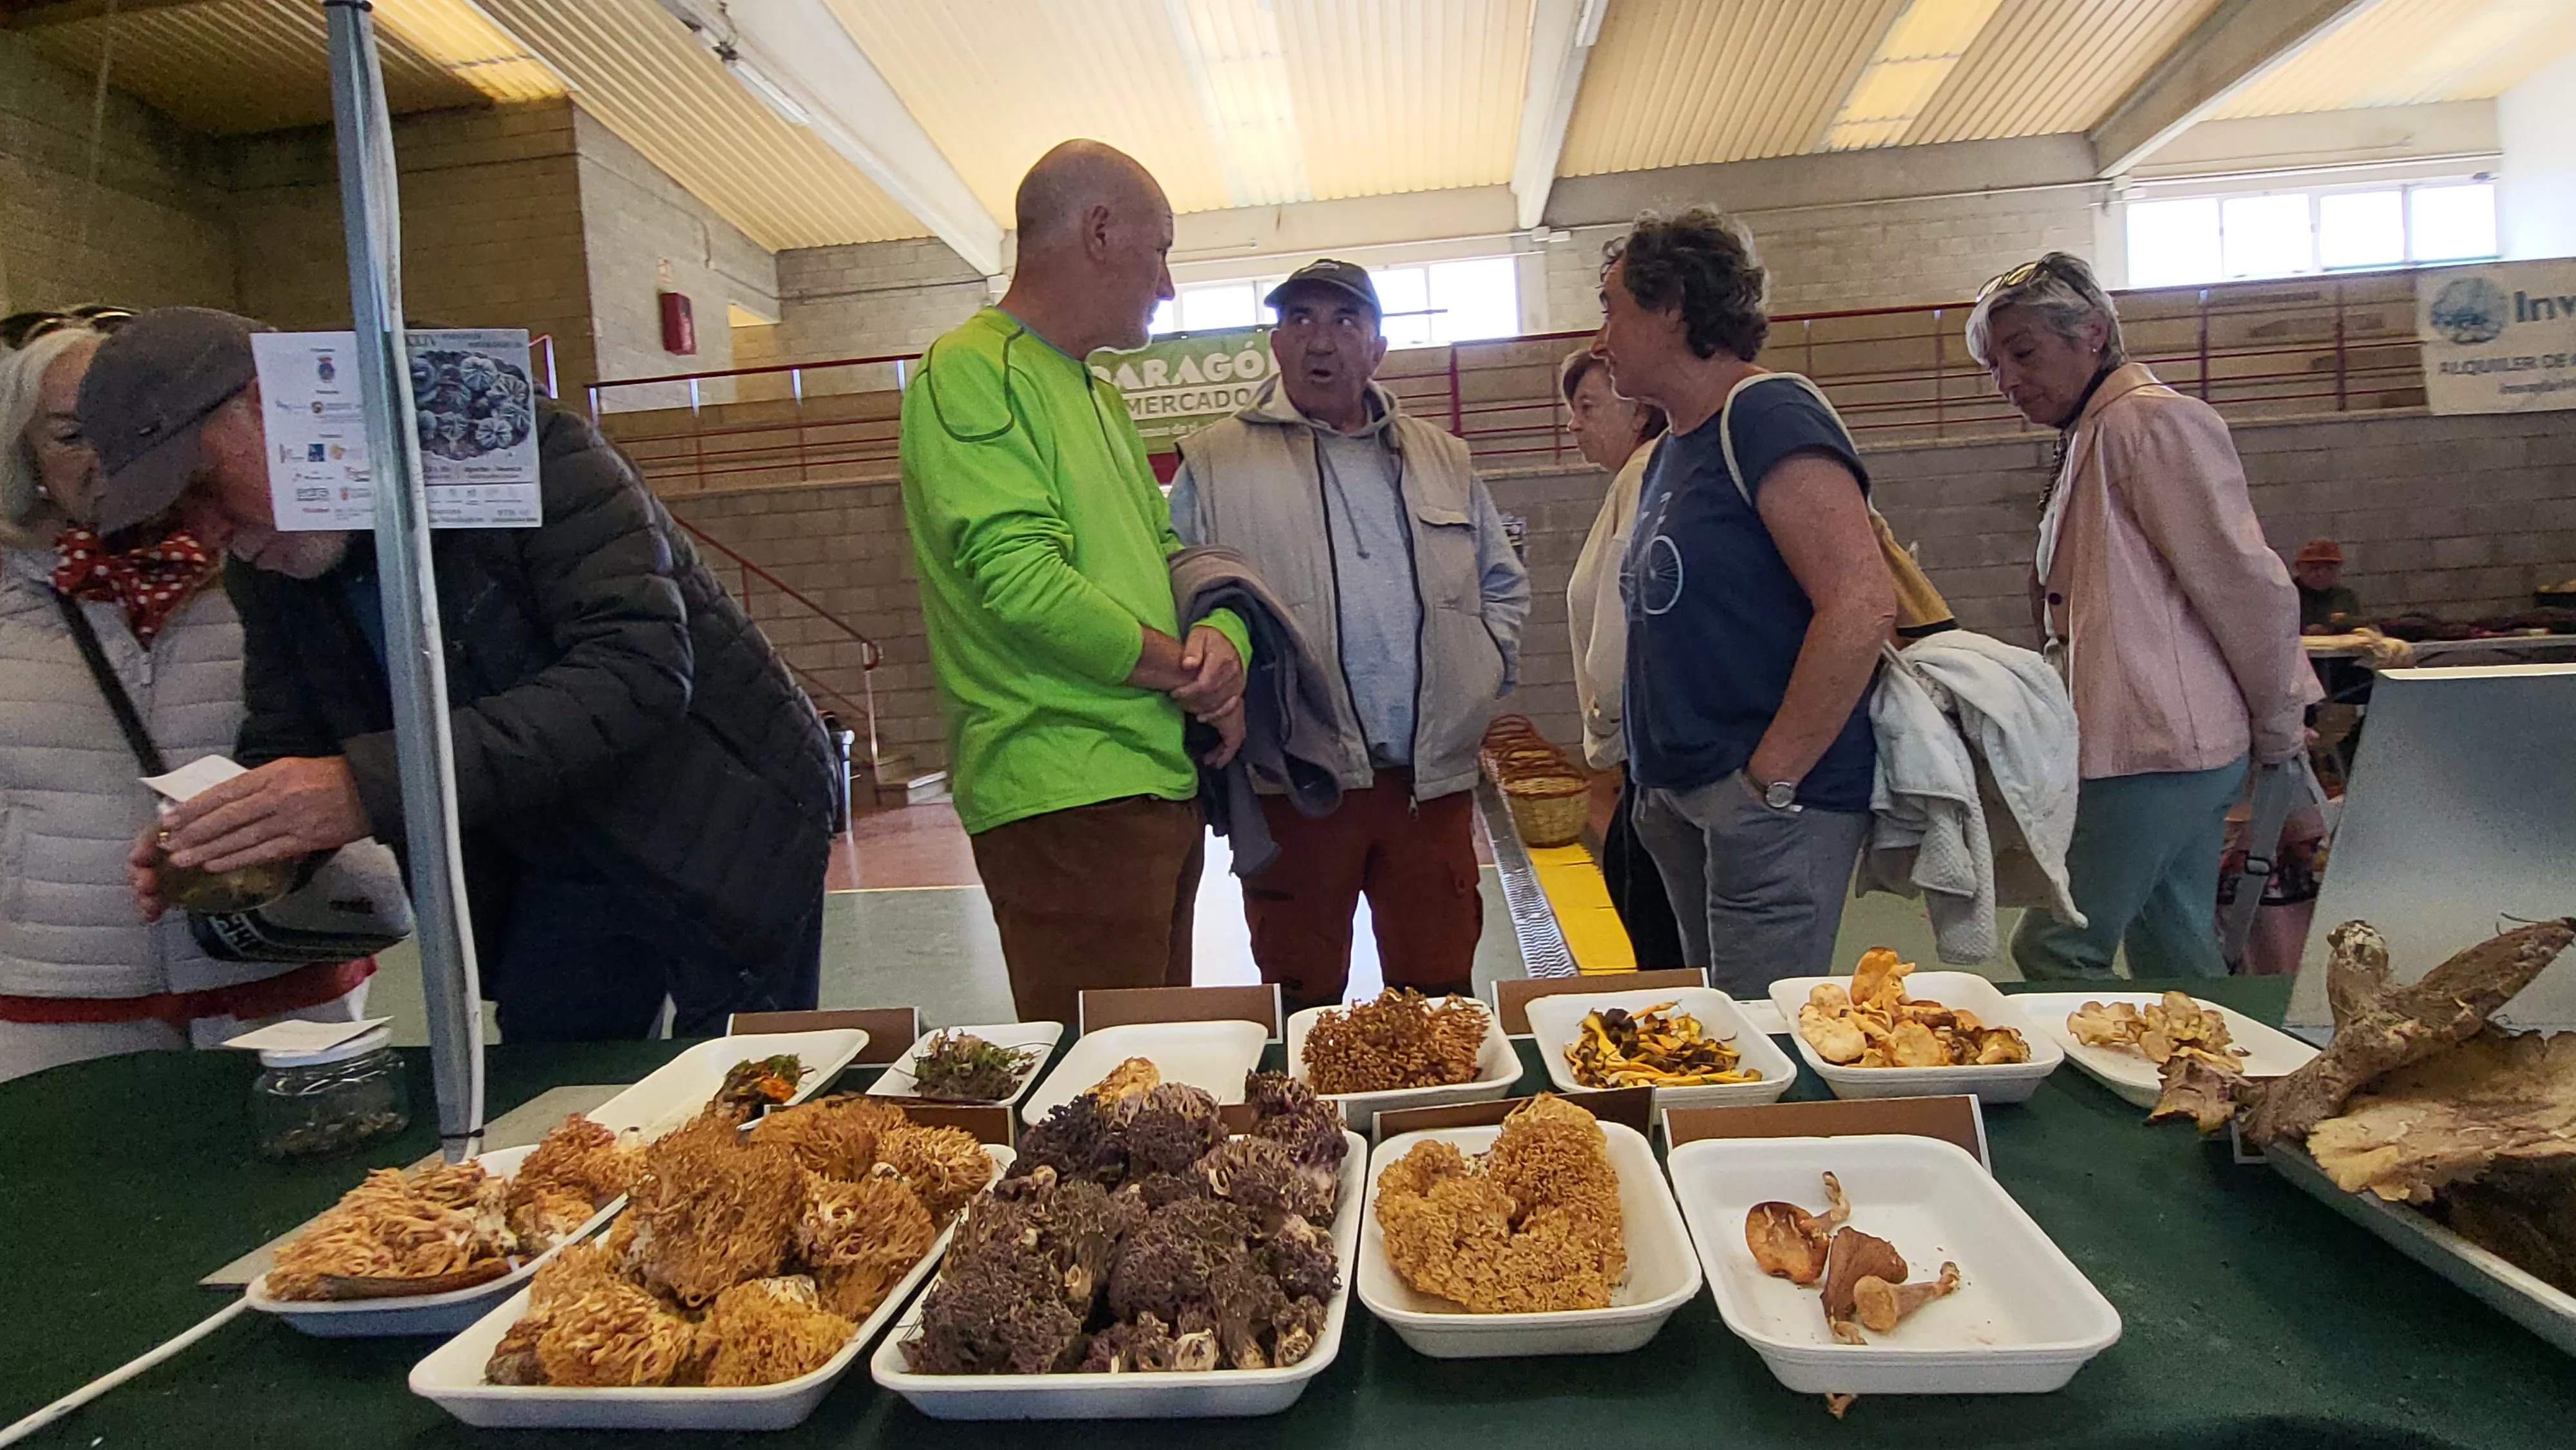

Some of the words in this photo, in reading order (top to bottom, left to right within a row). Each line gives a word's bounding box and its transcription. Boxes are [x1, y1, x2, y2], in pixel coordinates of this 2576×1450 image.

[2514, 290, 2576, 323] Inv
[1091, 341, 1280, 390] ARAGÓ
[1127, 388, 1251, 415] MERCADO
